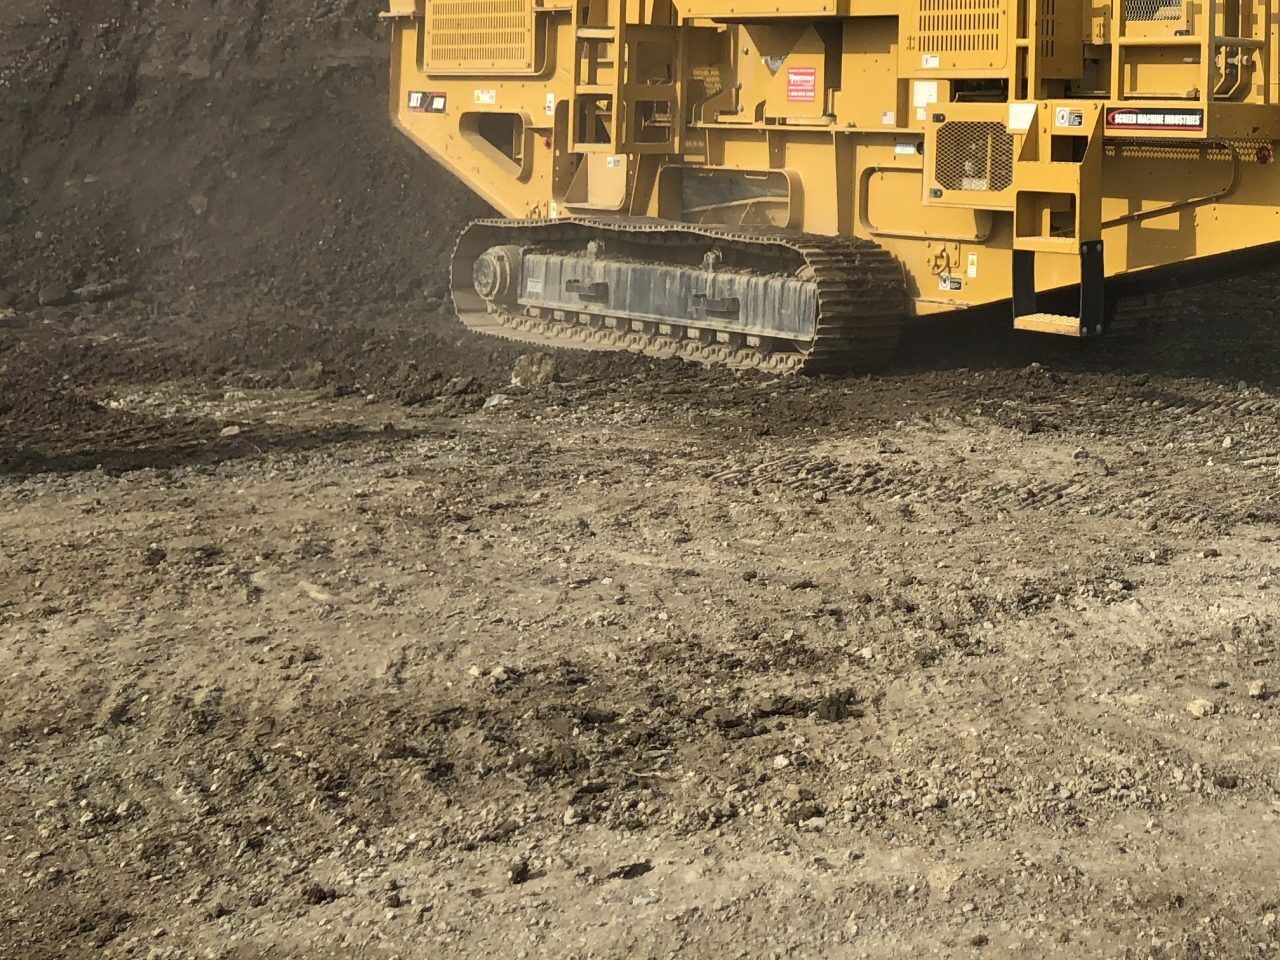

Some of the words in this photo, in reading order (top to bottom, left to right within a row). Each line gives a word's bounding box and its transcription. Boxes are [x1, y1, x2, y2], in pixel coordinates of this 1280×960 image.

[1114, 113, 1137, 124] SCREEN
[1137, 113, 1164, 125] MACHINE
[1164, 114, 1201, 126] INDUSTRIES
